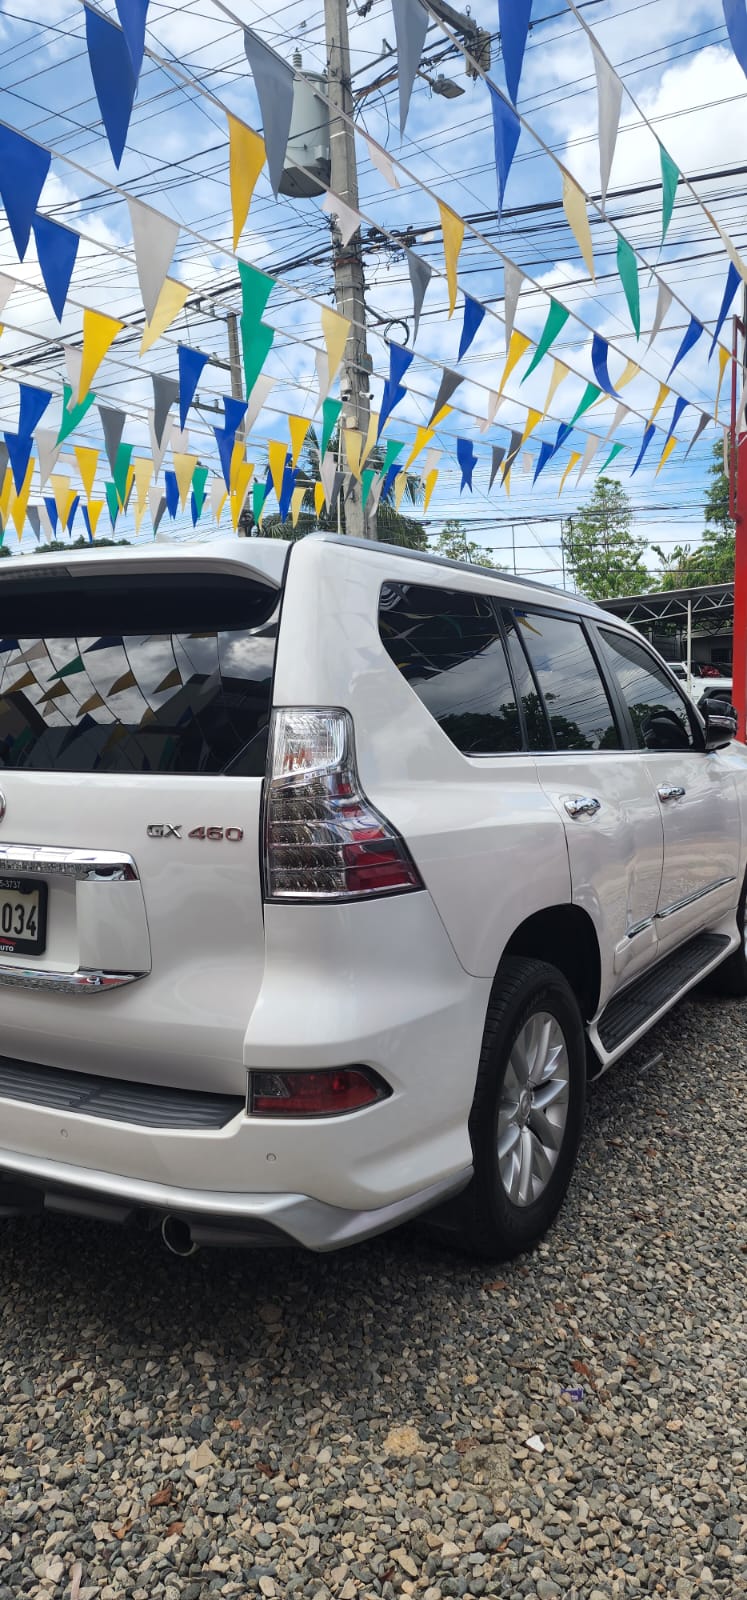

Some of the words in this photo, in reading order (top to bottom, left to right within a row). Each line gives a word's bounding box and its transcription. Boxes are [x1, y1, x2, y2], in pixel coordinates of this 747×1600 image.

[146, 823, 183, 839] GX
[187, 826, 244, 842] 460
[2, 902, 37, 937] 034
